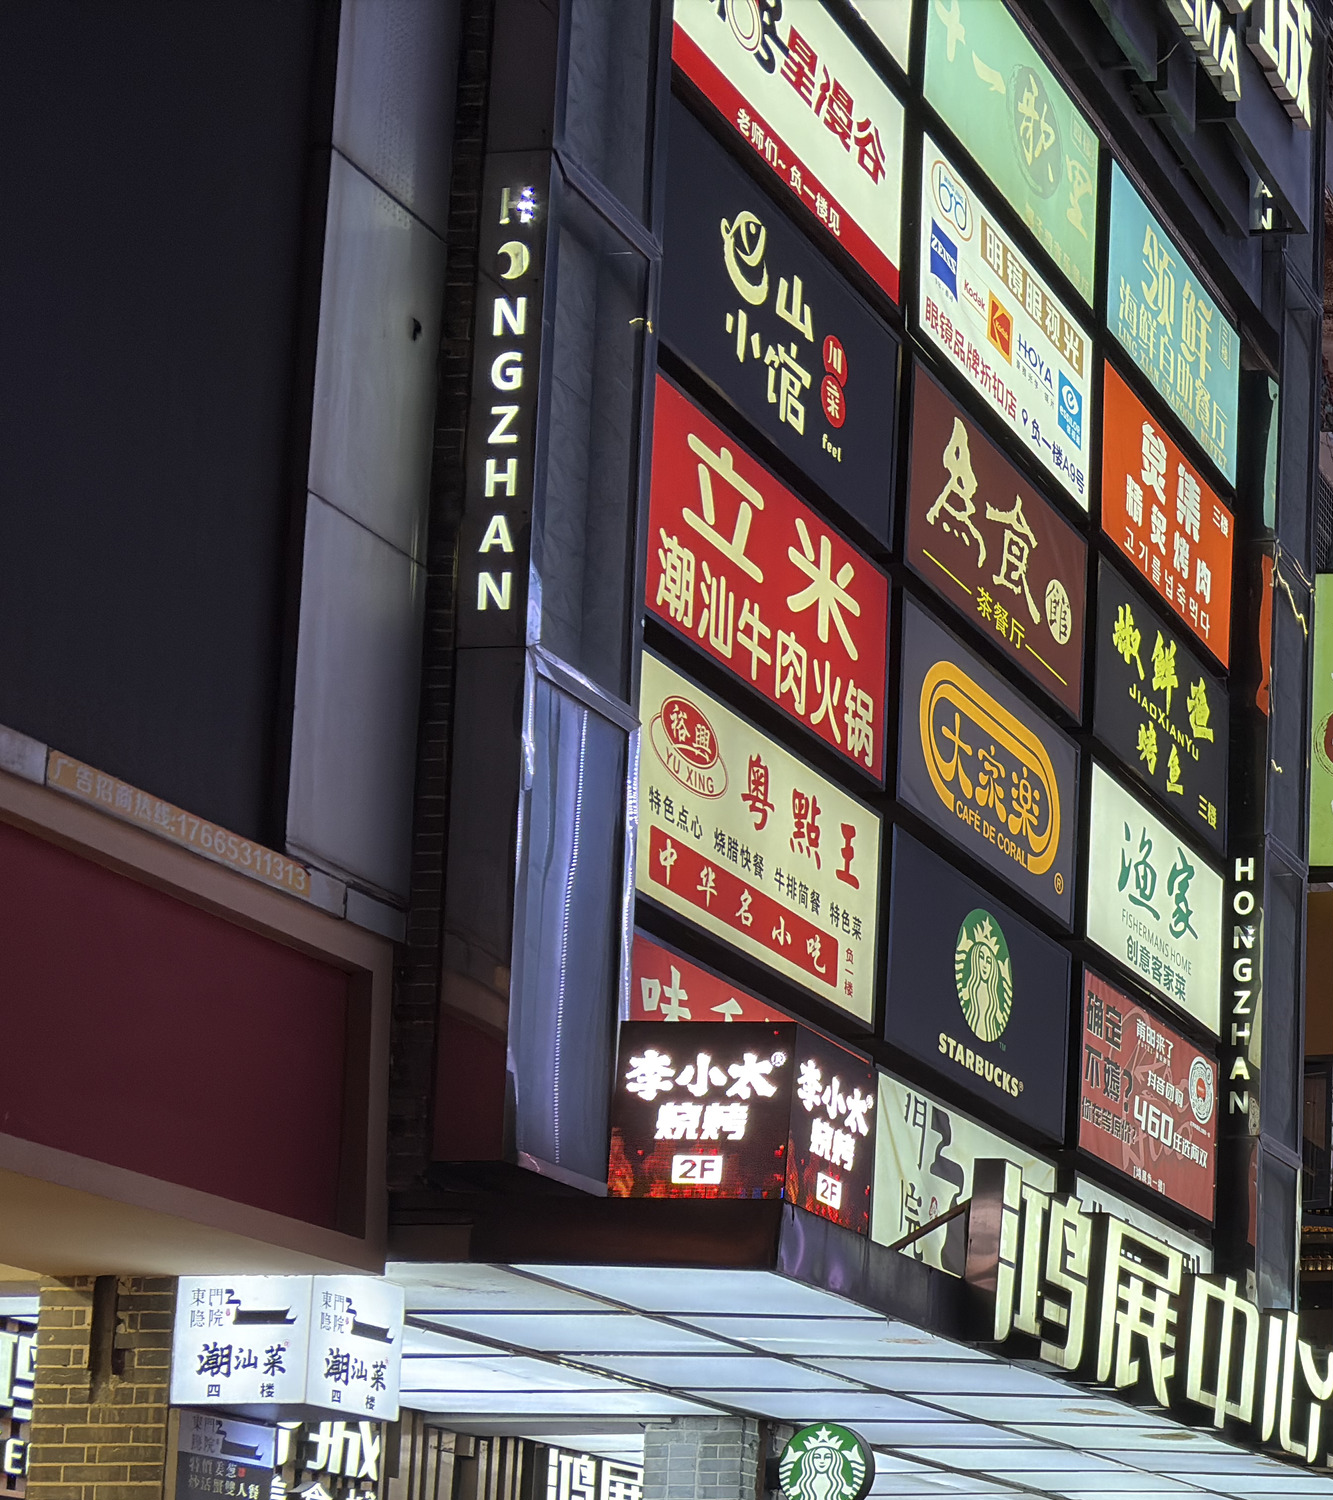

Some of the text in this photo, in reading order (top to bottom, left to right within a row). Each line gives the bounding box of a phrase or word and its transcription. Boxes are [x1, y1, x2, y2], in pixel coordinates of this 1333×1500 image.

[780, 25, 887, 185] 星漫谷
[931, 234, 957, 275] ZEISS
[964, 279, 985, 310] Kodak
[985, 225, 1080, 371] 明镜眼视光
[1142, 225, 1213, 382] 领鲜
[724, 308, 812, 437] 小馆
[926, 296, 1017, 422] 眼镜品牌折扣店
[1018, 334, 1053, 390] HOYA
[1120, 275, 1228, 449] 海鲜自助餐厅
[477, 186, 536, 611] HONGZHAN
[822, 433, 842, 463] feel
[1031, 418, 1085, 494] 负一楼A9号
[682, 433, 861, 661] 立米
[1212, 504, 1229, 539] 三楼
[656, 527, 873, 768] 潮汕牛肉火锅
[977, 586, 1026, 650] 茶餐厅
[1129, 682, 1200, 762] JIAOXIANYU
[664, 746, 715, 794] YU XING
[1136, 721, 1184, 796] 烤鱼
[983, 819, 995, 841] DE
[996, 831, 1028, 869] CORAL
[1198, 795, 1217, 831] 三楼
[649, 786, 863, 941] 特色点心 烧腊快餐 牛排简餐 特色菜
[1118, 821, 1199, 942] 渔家
[659, 839, 826, 974] 中华名小吃
[844, 947, 855, 999] 负一楼
[1121, 908, 1193, 977] FISHERMANS HOME
[1125, 934, 1188, 1002] 创意客家菜
[1229, 857, 1256, 1115] HONGZHAN
[1086, 989, 1122, 1051] 确定
[937, 1032, 1019, 1098] STARBUCKS
[1147, 1070, 1184, 1109] 抖音团购
[653, 1102, 749, 1141] 烧烤
[809, 1117, 856, 1171] 烧烤
[1134, 1095, 1174, 1149] 460
[1172, 1132, 1208, 1168] 任选两双
[675, 1158, 716, 1180] 2F
[820, 1177, 838, 1201] 2F
[196, 1342, 287, 1378] 潮汕菜
[207, 1383, 275, 1399] 四楼
[323, 1348, 387, 1392] 潮汕菜
